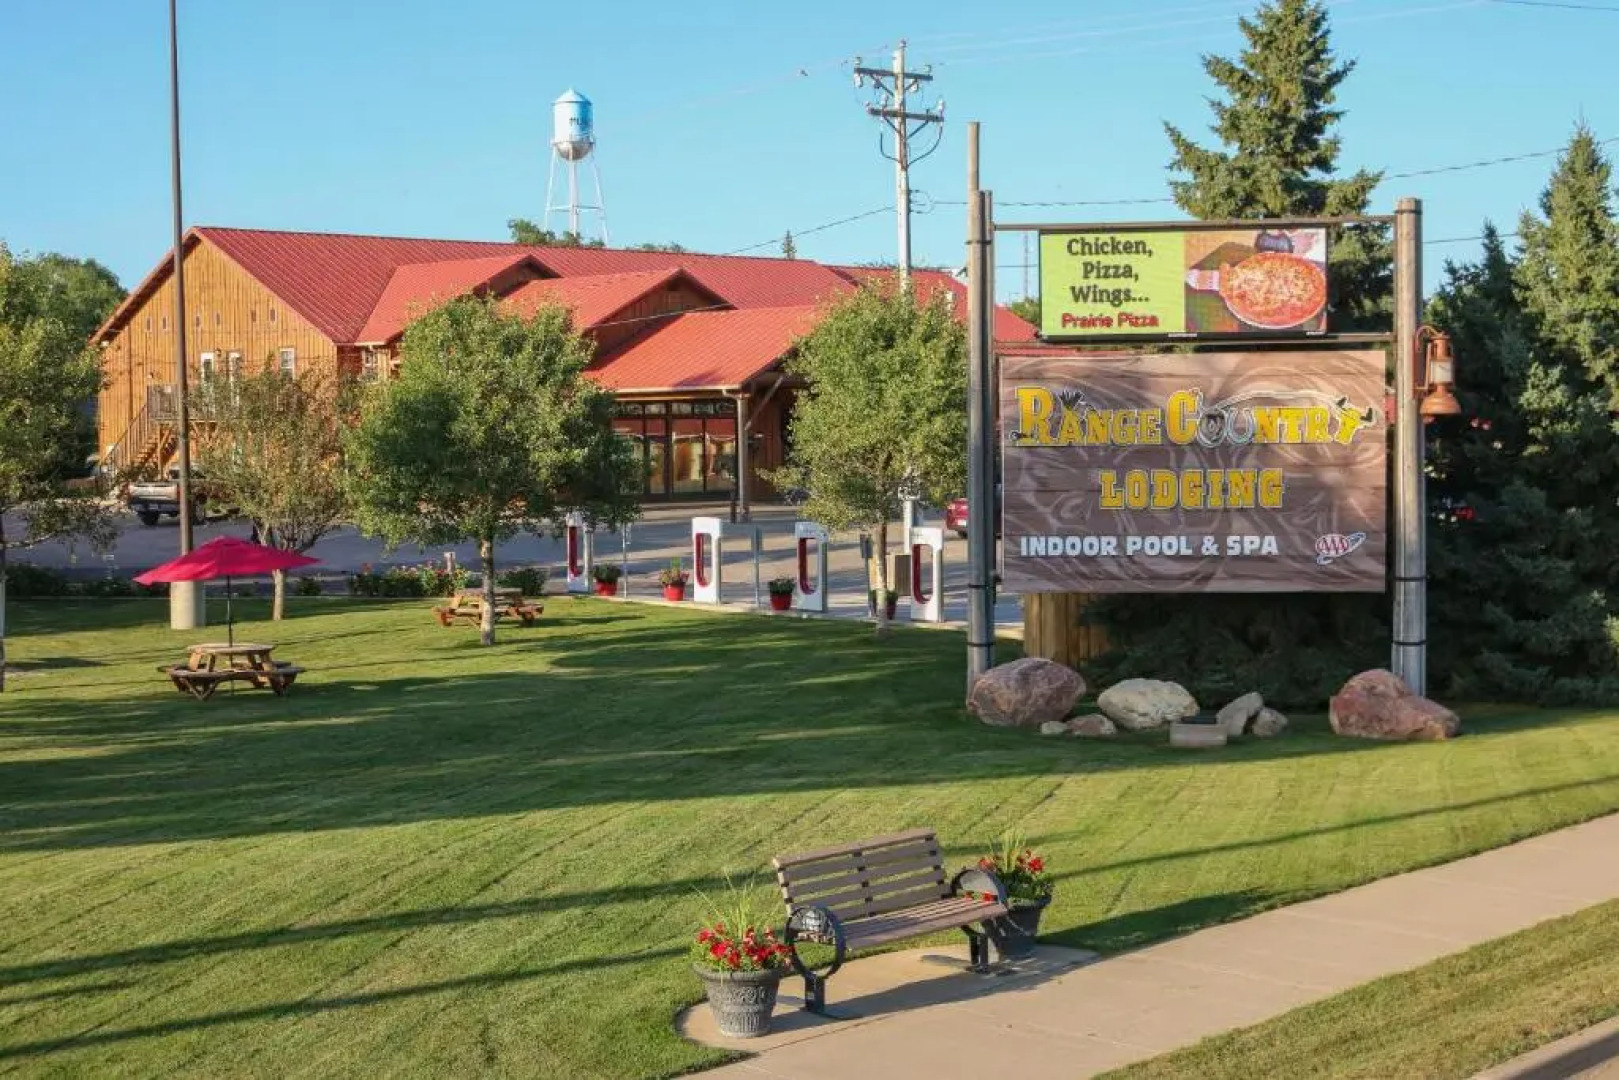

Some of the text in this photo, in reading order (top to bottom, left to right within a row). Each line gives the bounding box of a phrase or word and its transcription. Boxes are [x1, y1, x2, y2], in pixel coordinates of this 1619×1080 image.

[1066, 236, 1153, 257] Chicken,
[1082, 261, 1139, 282] Pizza,
[1070, 285, 1150, 307] Wings...
[1061, 311, 1159, 328] Prairie Pizza
[1015, 386, 1374, 447] RANGE COUNTRY
[1100, 468, 1284, 509] LODGING
[1020, 535, 1279, 556] INDOOR POOL & SPA
